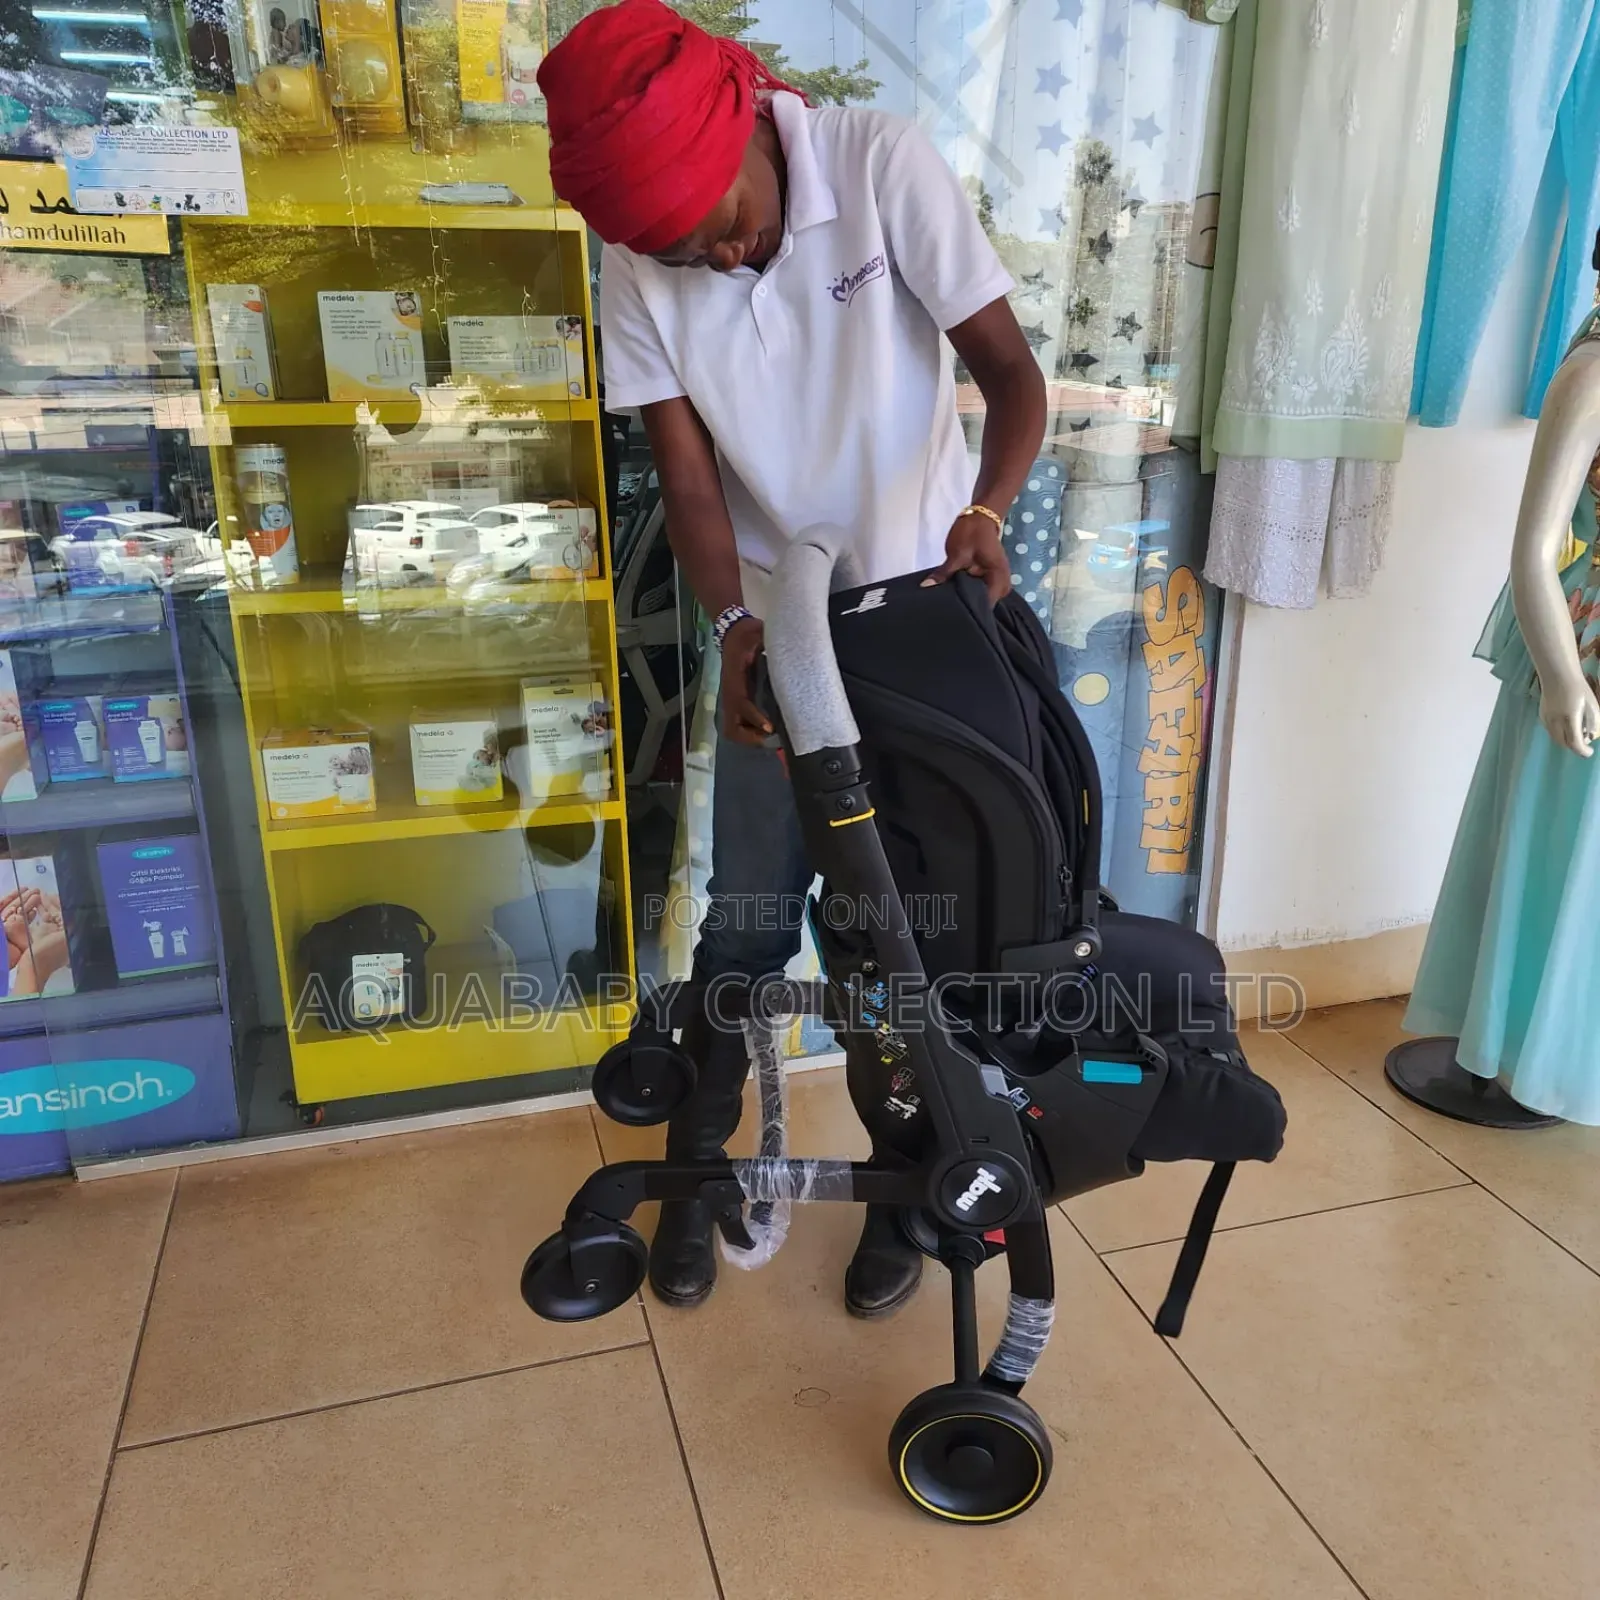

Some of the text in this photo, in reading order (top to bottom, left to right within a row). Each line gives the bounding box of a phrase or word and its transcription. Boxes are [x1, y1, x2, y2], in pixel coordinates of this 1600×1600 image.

[212, 131, 229, 139] LTD
[322, 294, 355, 302] medela
[452, 318, 484, 327] medela
[531, 704, 559, 714] medela
[270, 753, 301, 761] medela
